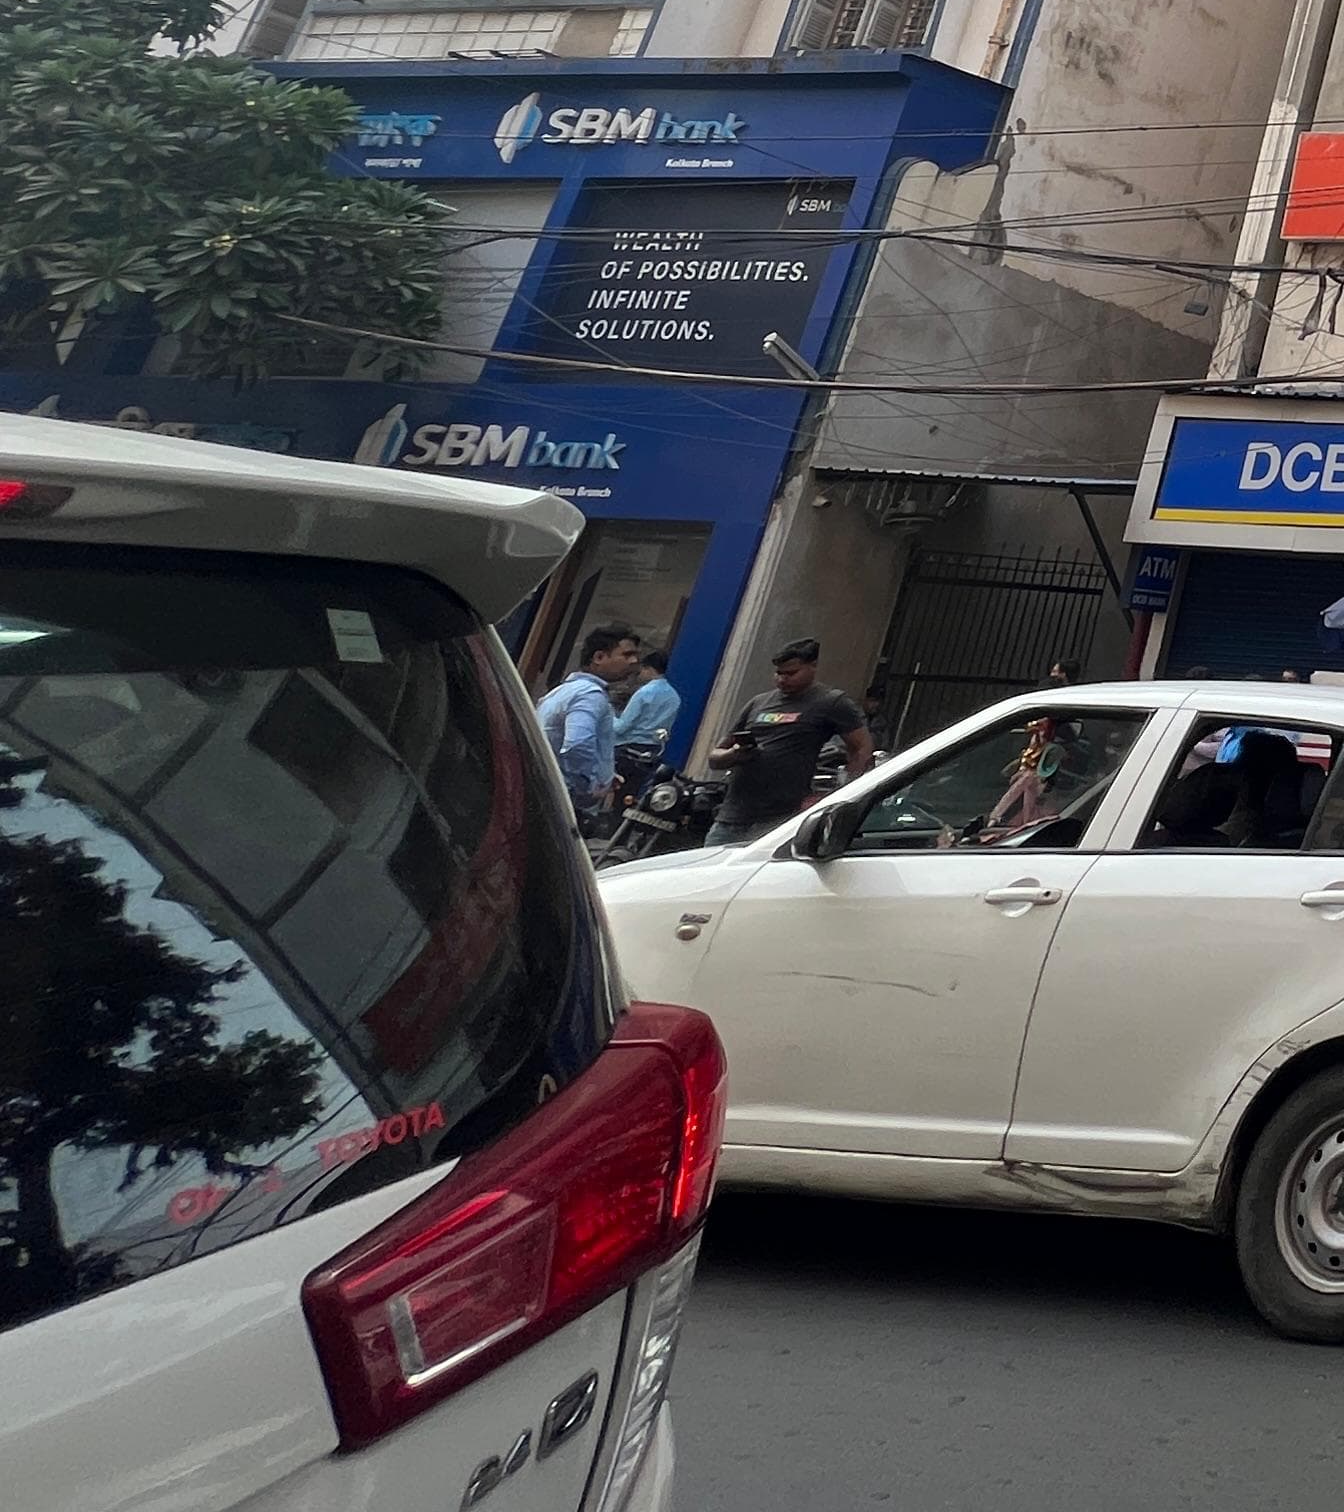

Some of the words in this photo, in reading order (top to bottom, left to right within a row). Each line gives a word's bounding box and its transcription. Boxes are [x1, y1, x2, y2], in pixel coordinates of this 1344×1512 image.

[541, 107, 657, 144] SBM
[655, 112, 748, 144] bank
[799, 198, 832, 213] SBM
[600, 260, 634, 281] OF
[637, 260, 809, 282] POSSIBILITIES.
[587, 289, 691, 310] INFINITE
[576, 319, 714, 341] SOLUTIONS.
[403, 423, 530, 468] SBM
[526, 431, 627, 470] bank
[1138, 555, 1177, 580] ATM
[315, 1101, 446, 1170] TOYOTA
